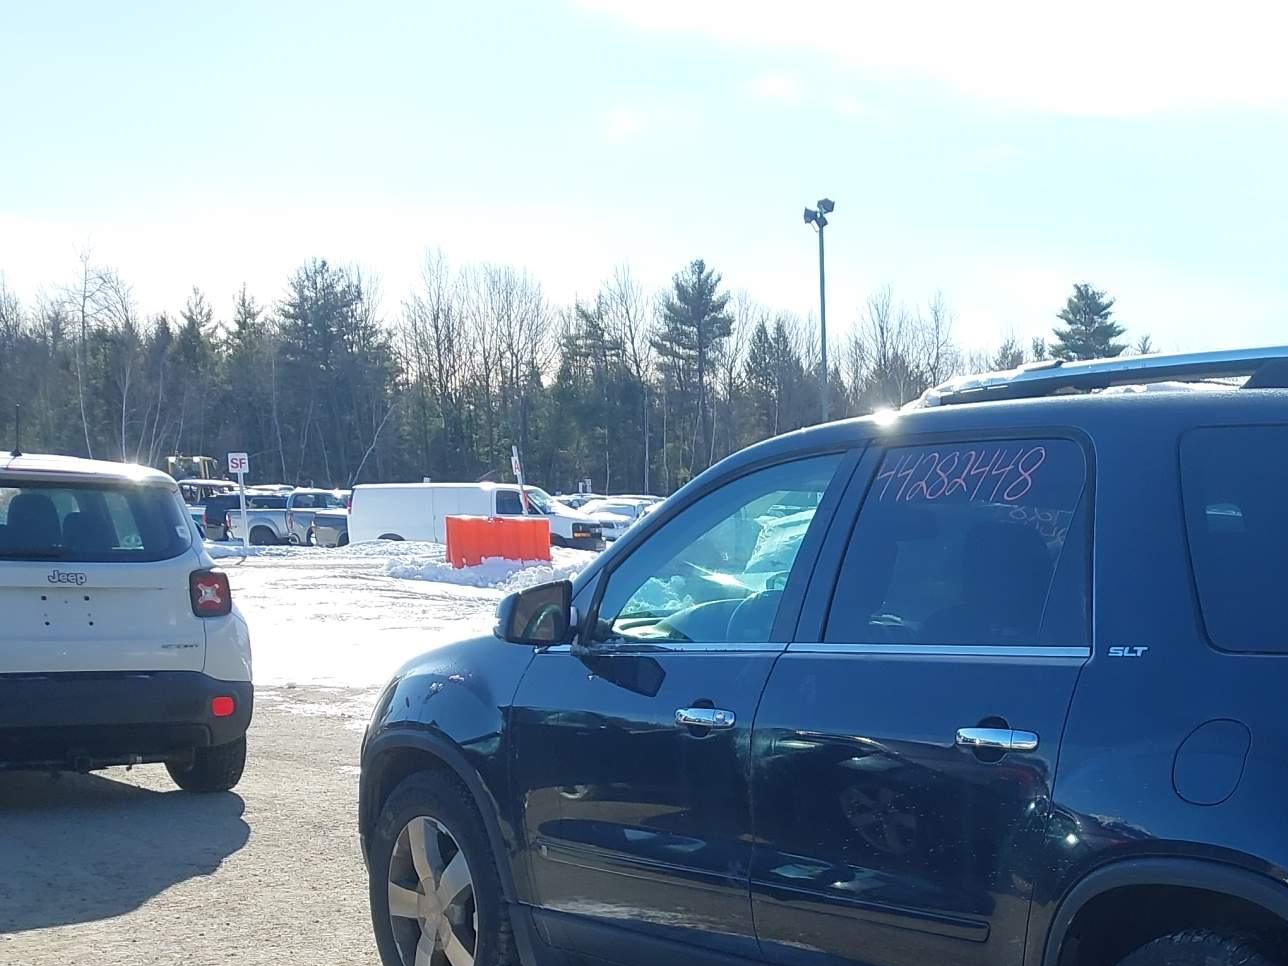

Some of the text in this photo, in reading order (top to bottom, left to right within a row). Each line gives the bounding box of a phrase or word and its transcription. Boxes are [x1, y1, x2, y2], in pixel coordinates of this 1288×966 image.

[230, 457, 246, 469] SF
[876, 446, 1046, 502] 44282448
[48, 570, 87, 585] Jeep
[1108, 646, 1149, 657] SLT
